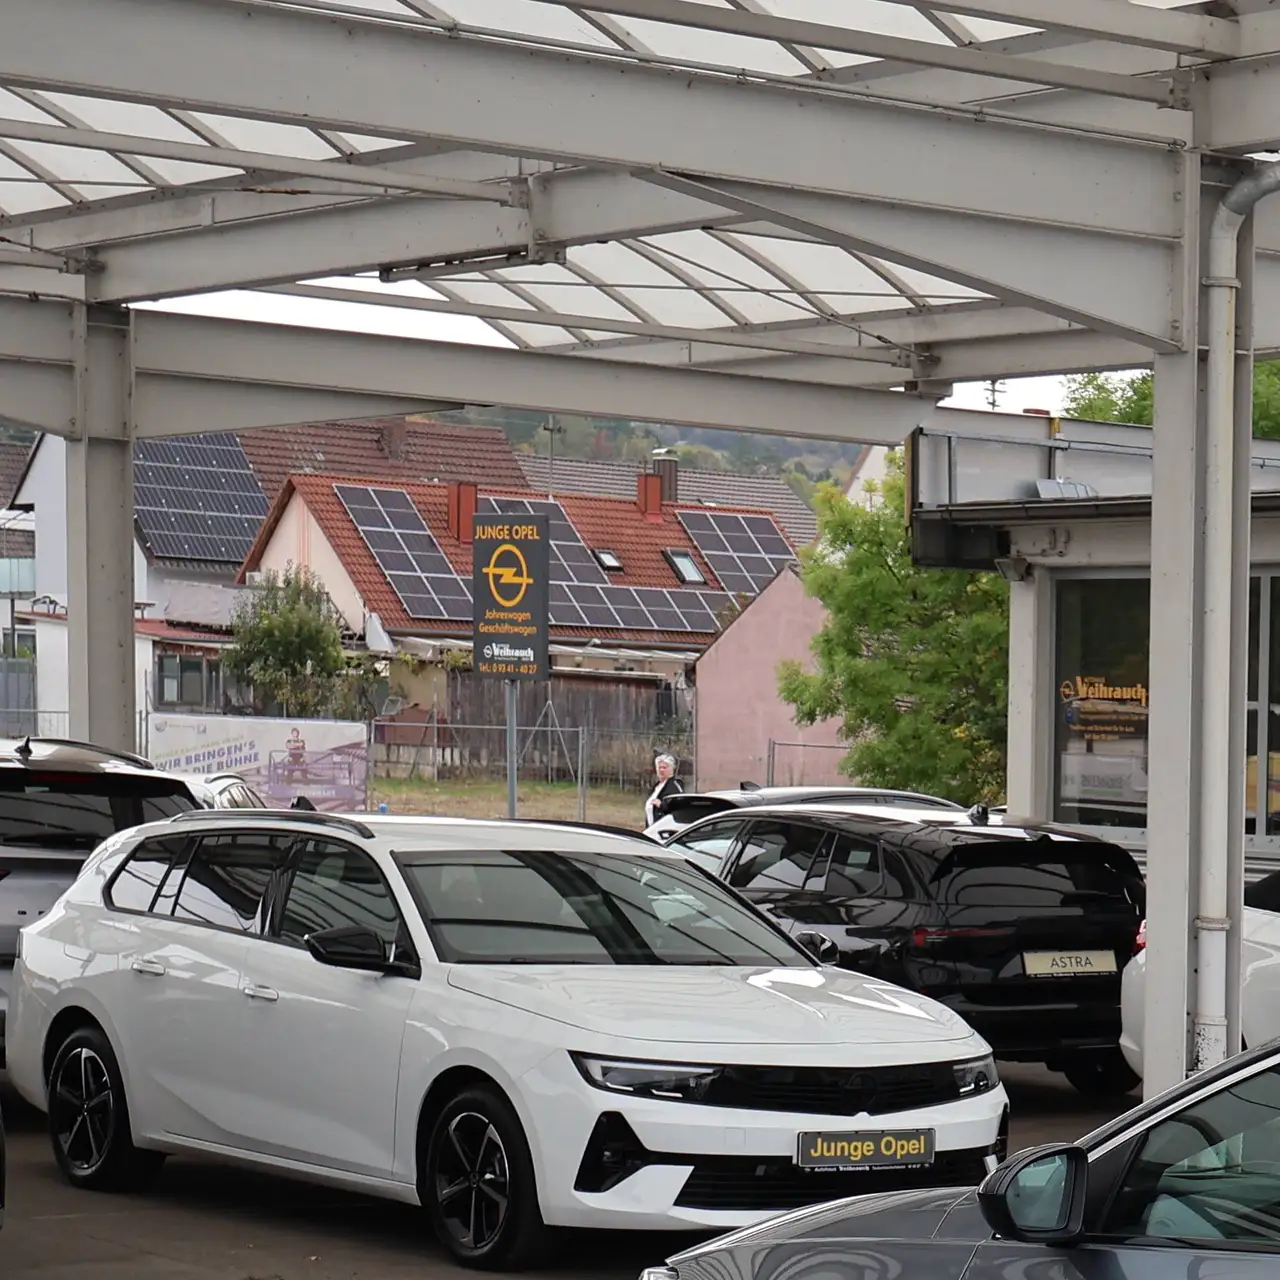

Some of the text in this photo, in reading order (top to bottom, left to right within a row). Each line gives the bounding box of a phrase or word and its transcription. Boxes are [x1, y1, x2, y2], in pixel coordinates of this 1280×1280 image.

[475, 525, 540, 540] JUNGE OPEL
[484, 609, 532, 623] Jahreswagen
[479, 622, 538, 636] Geschäftswagen
[1050, 956, 1093, 969] ASTRA
[810, 1135, 925, 1161] Junge Opel
